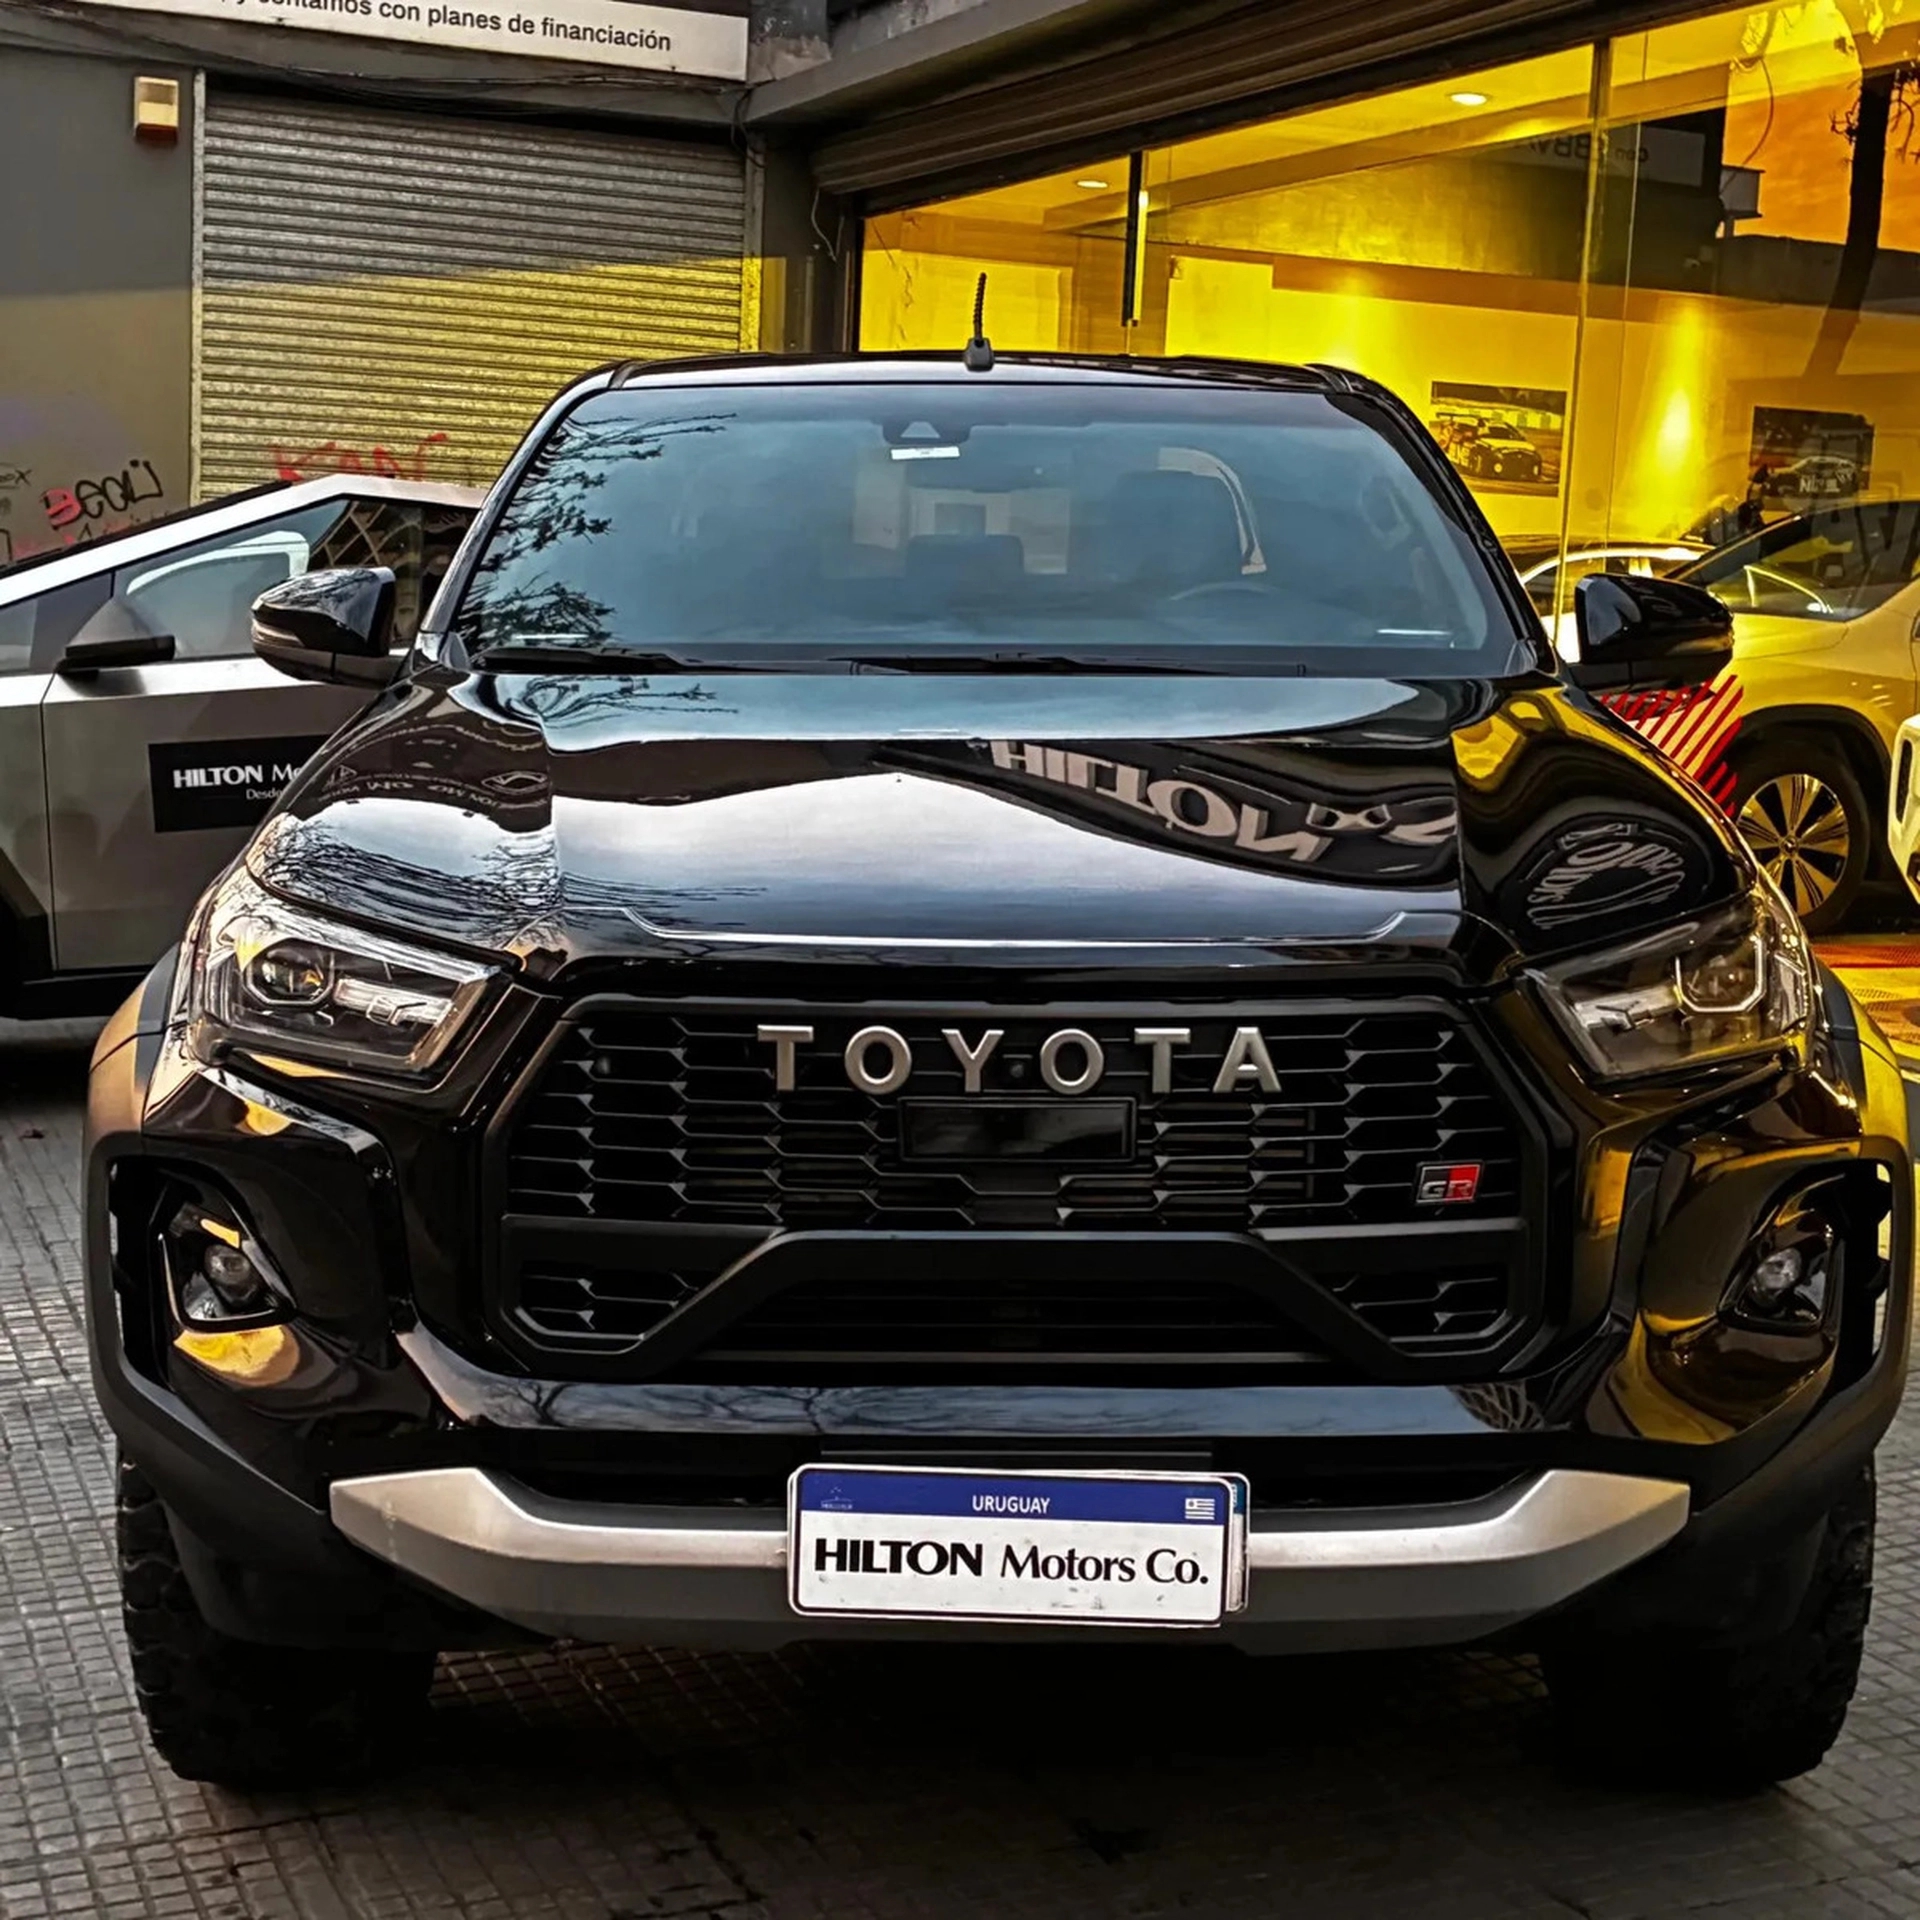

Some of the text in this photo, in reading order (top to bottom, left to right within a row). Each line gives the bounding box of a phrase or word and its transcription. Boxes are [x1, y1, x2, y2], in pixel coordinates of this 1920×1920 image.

[259, 0, 672, 51] ntamos con planes de financiación
[173, 764, 264, 788] HILTON
[757, 1024, 1282, 1094] TOYOTA
[1421, 1180, 1474, 1200] GR
[972, 1495, 1050, 1514] URUGUAY
[815, 1538, 1209, 1584] HILTON Motors Co.
